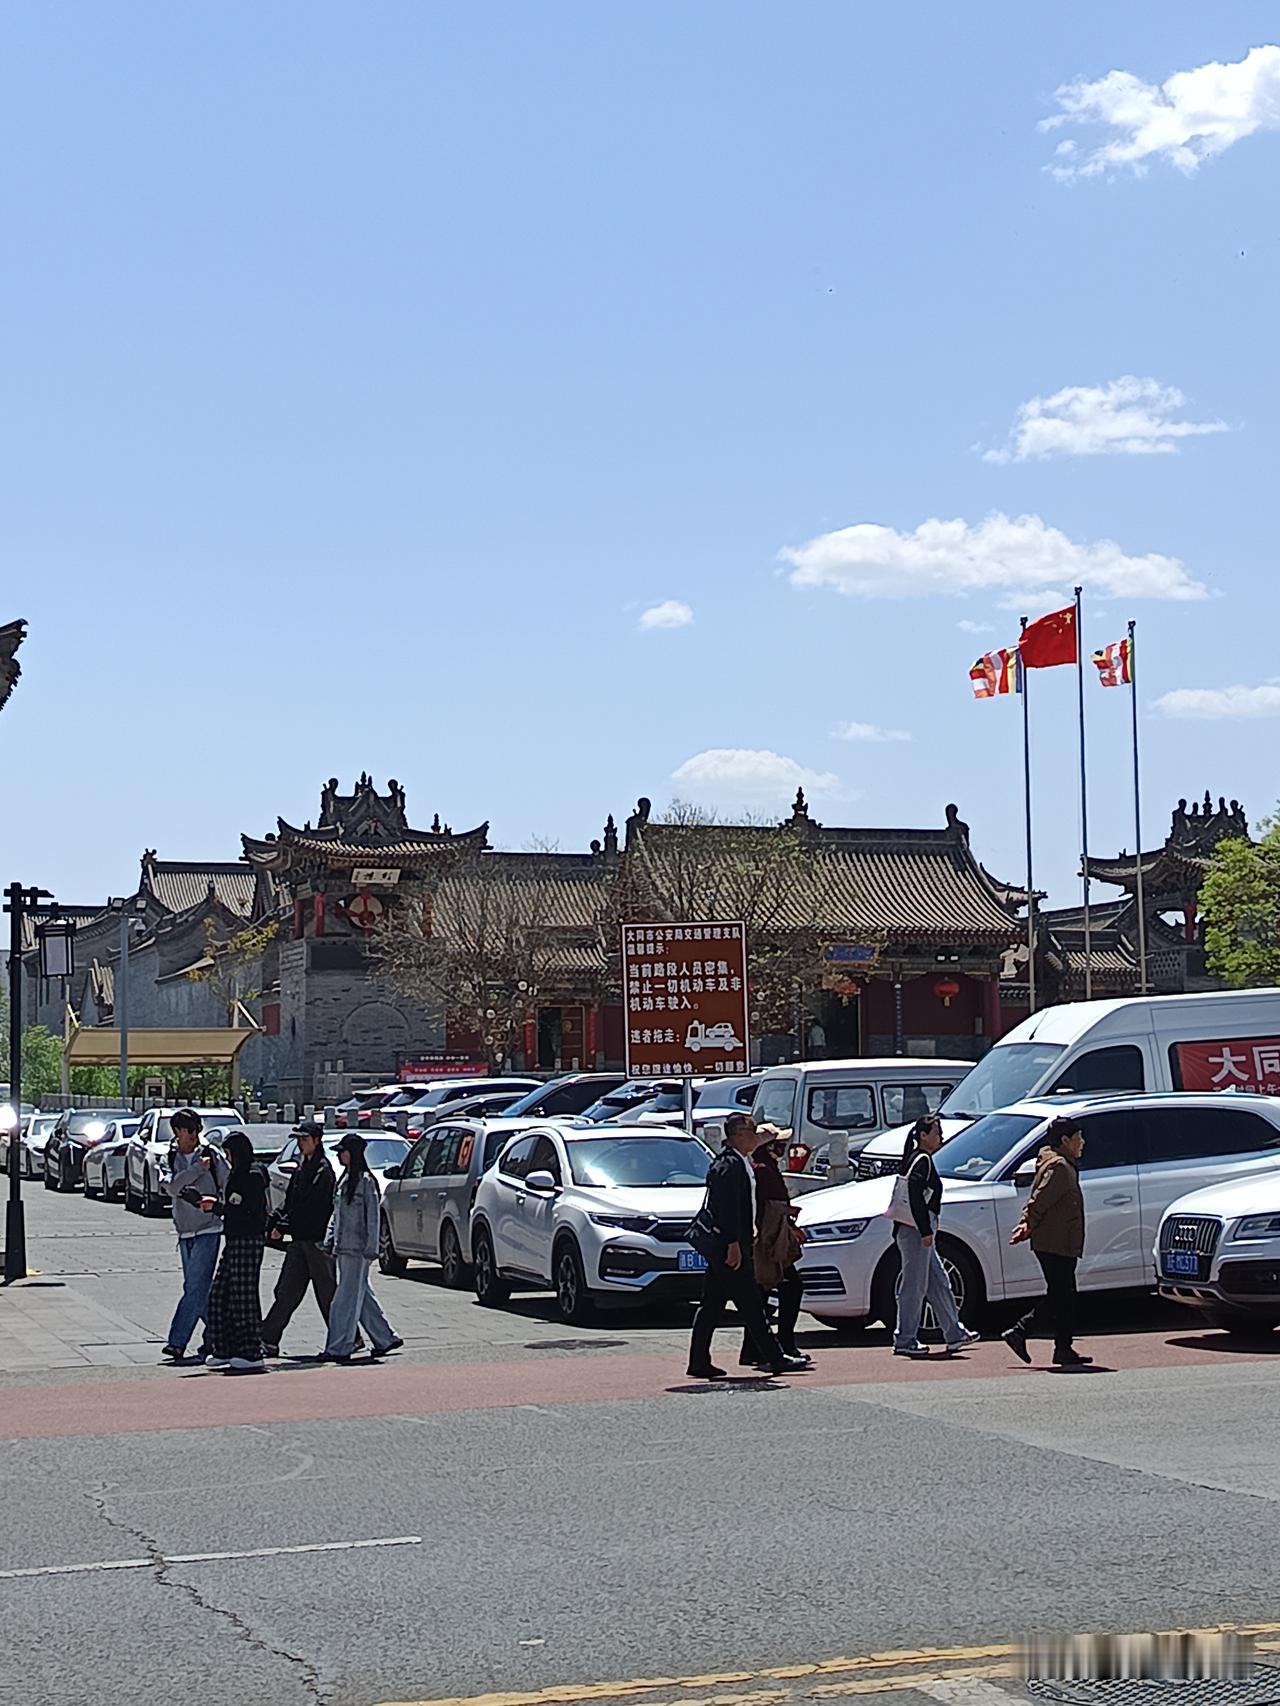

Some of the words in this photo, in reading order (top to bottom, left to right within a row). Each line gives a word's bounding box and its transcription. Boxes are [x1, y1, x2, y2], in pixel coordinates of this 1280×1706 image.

[627, 927, 740, 941] 大同市公安局交通管理支队
[629, 960, 734, 978] 当前路段人员密集，
[629, 977, 741, 994] 禁止一切机动车及非
[630, 996, 698, 1011] 机动车驶入。
[1208, 1045, 1280, 1083] 大同
